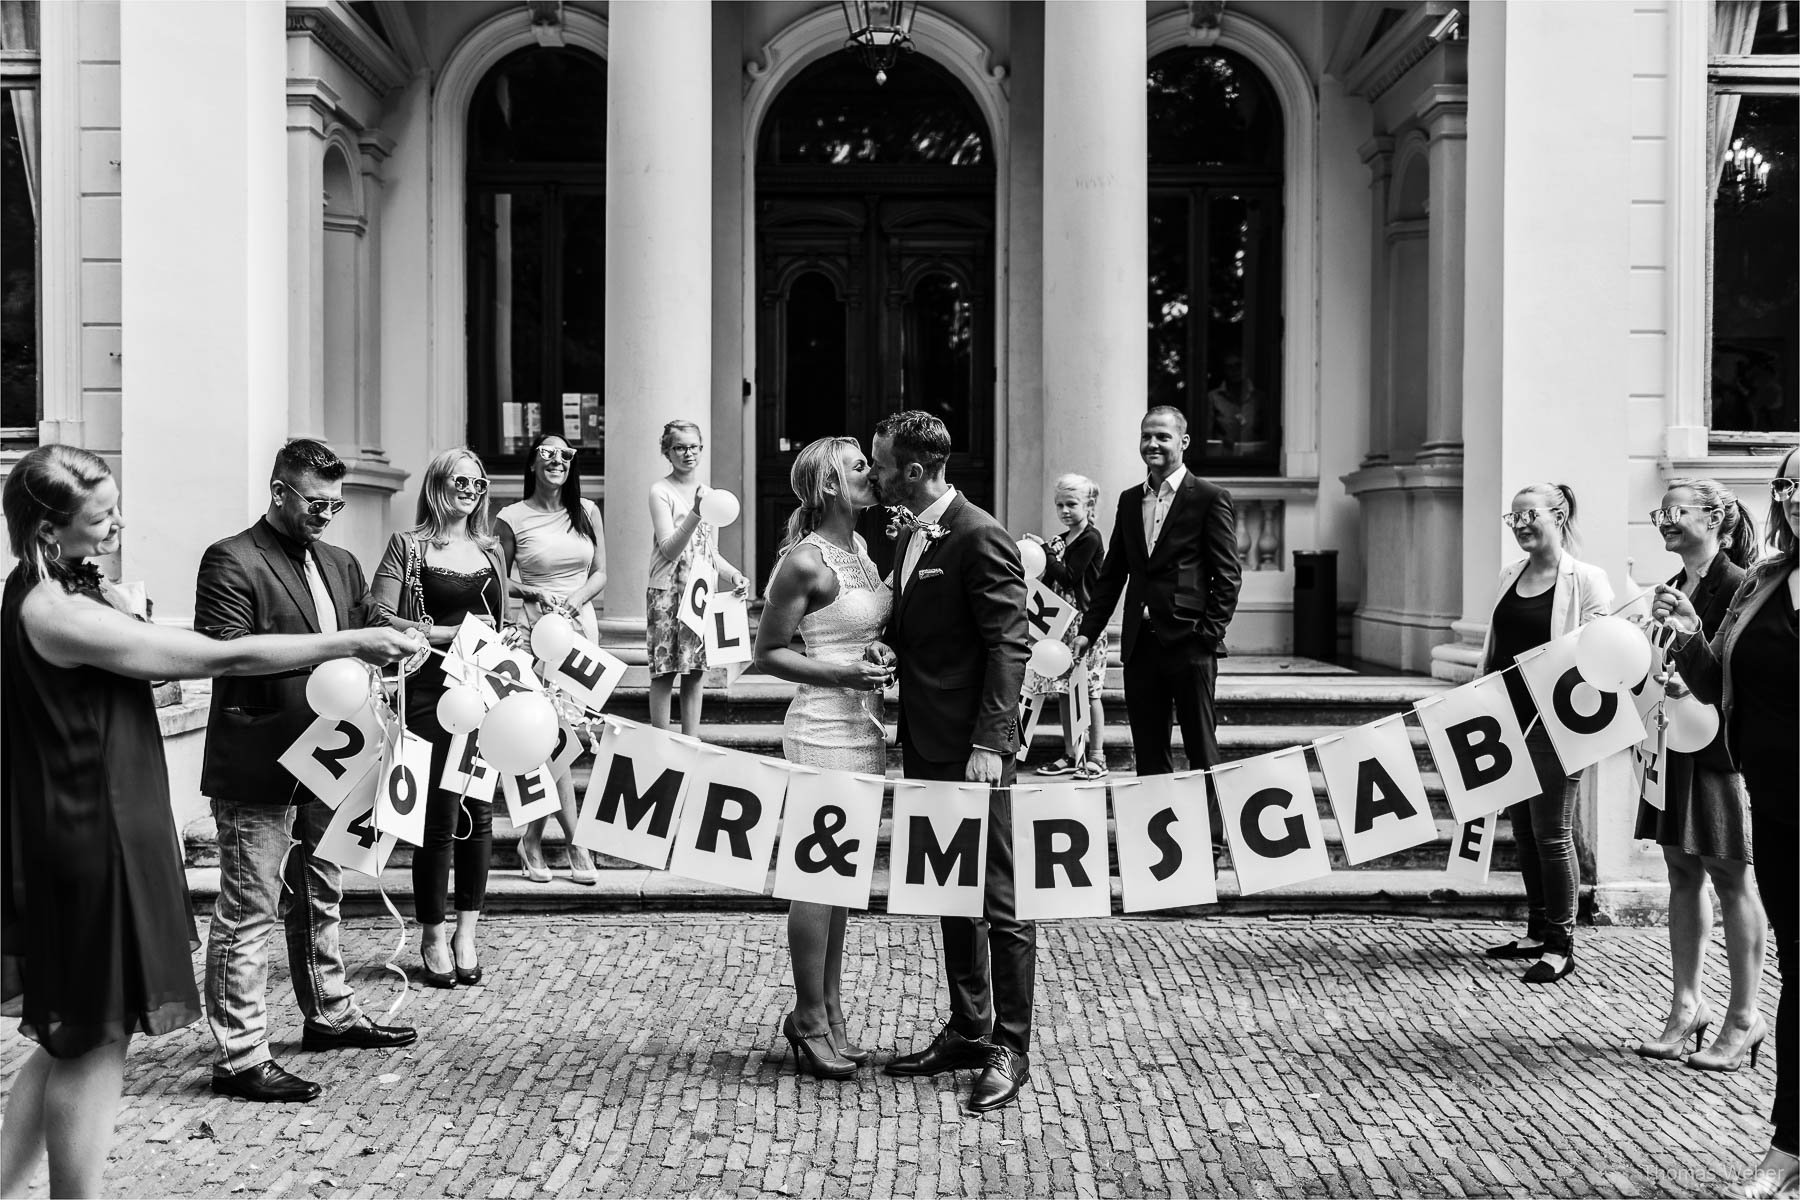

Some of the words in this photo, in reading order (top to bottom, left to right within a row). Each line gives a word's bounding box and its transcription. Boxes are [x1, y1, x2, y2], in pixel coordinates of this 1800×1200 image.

[714, 611, 740, 649] L
[1026, 590, 1060, 636] K
[558, 647, 607, 692] E
[311, 719, 365, 781] 2
[514, 766, 546, 807] E
[1458, 816, 1486, 863] E
